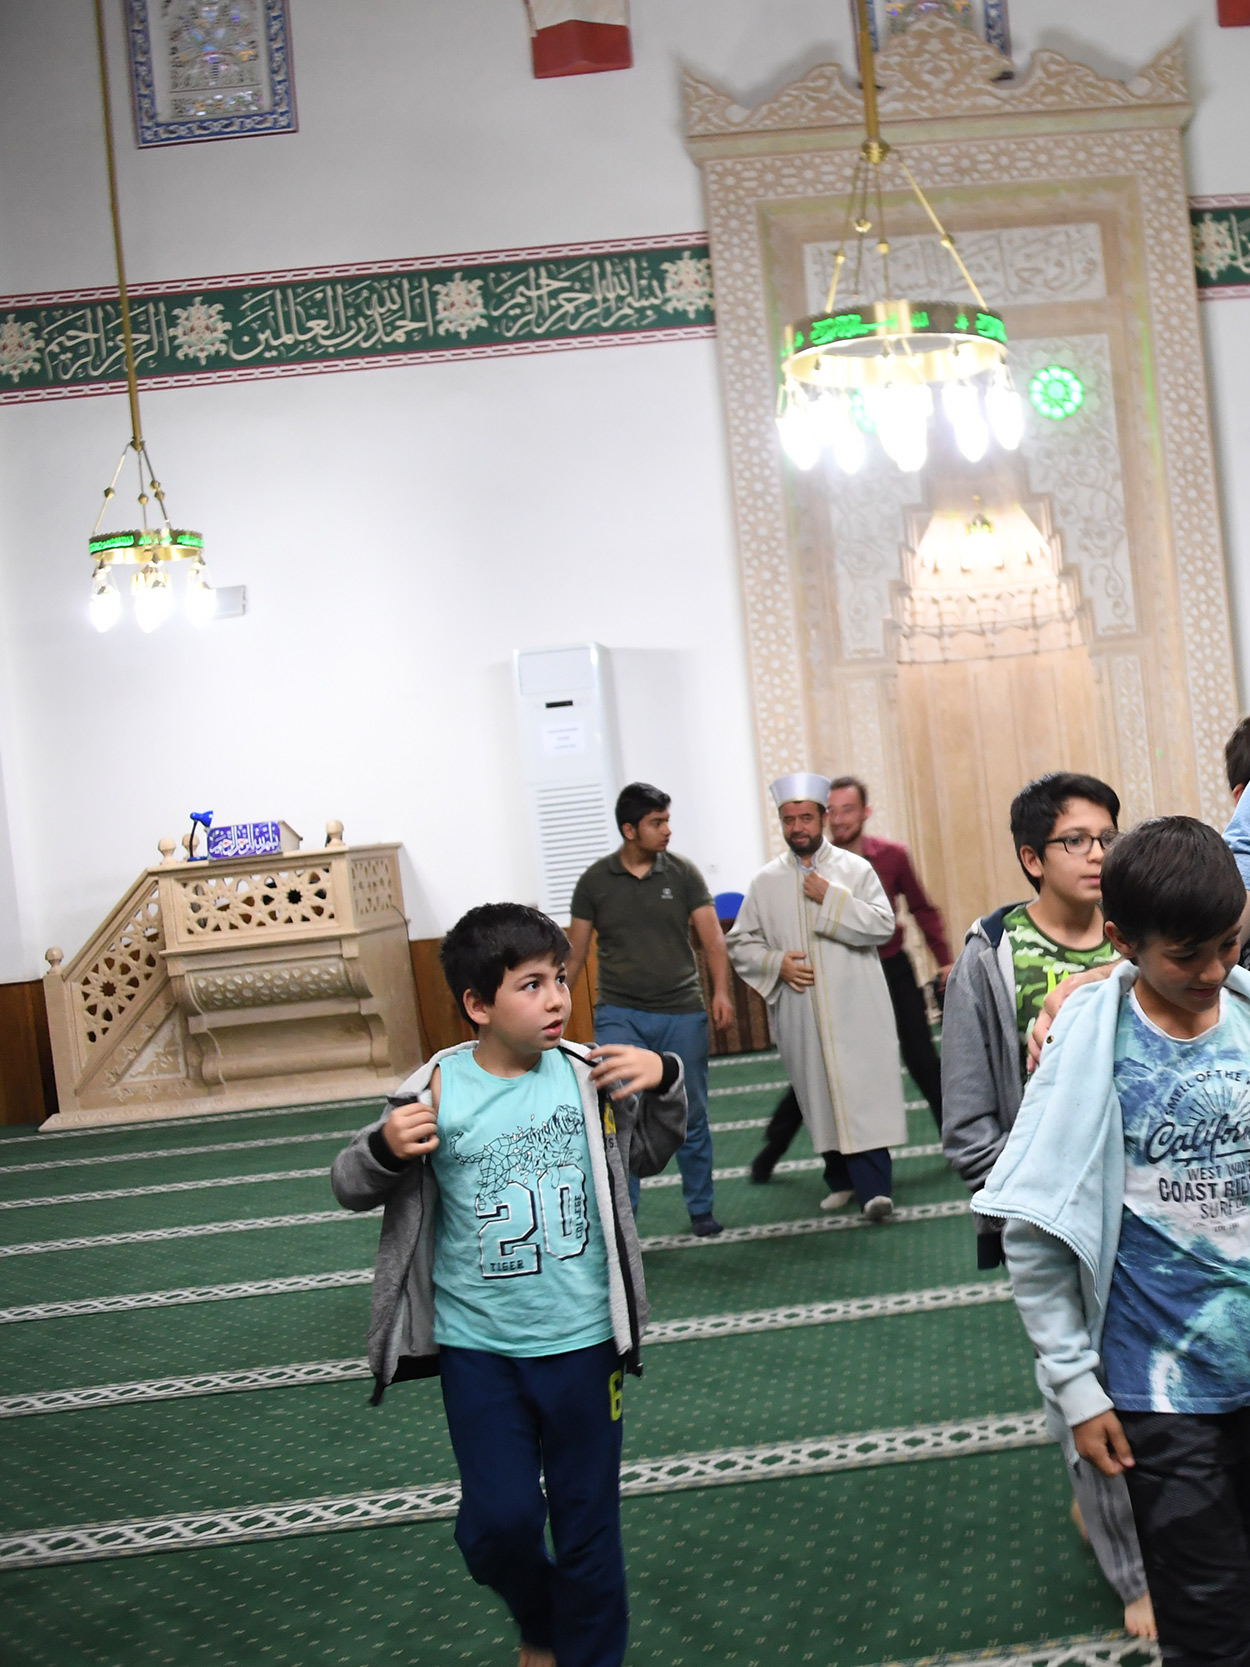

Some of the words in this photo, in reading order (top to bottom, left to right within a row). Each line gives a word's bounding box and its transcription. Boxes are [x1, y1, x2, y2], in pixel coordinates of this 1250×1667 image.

[1164, 1080, 1196, 1117] SMELL
[1195, 1070, 1212, 1083] OF
[1215, 1069, 1242, 1082] THE
[1187, 1164, 1222, 1181] WEST
[1159, 1177, 1219, 1203] COAST
[1200, 1199, 1233, 1219] SURF
[475, 1164, 590, 1280] 20
[490, 1259, 525, 1272] TIGER
